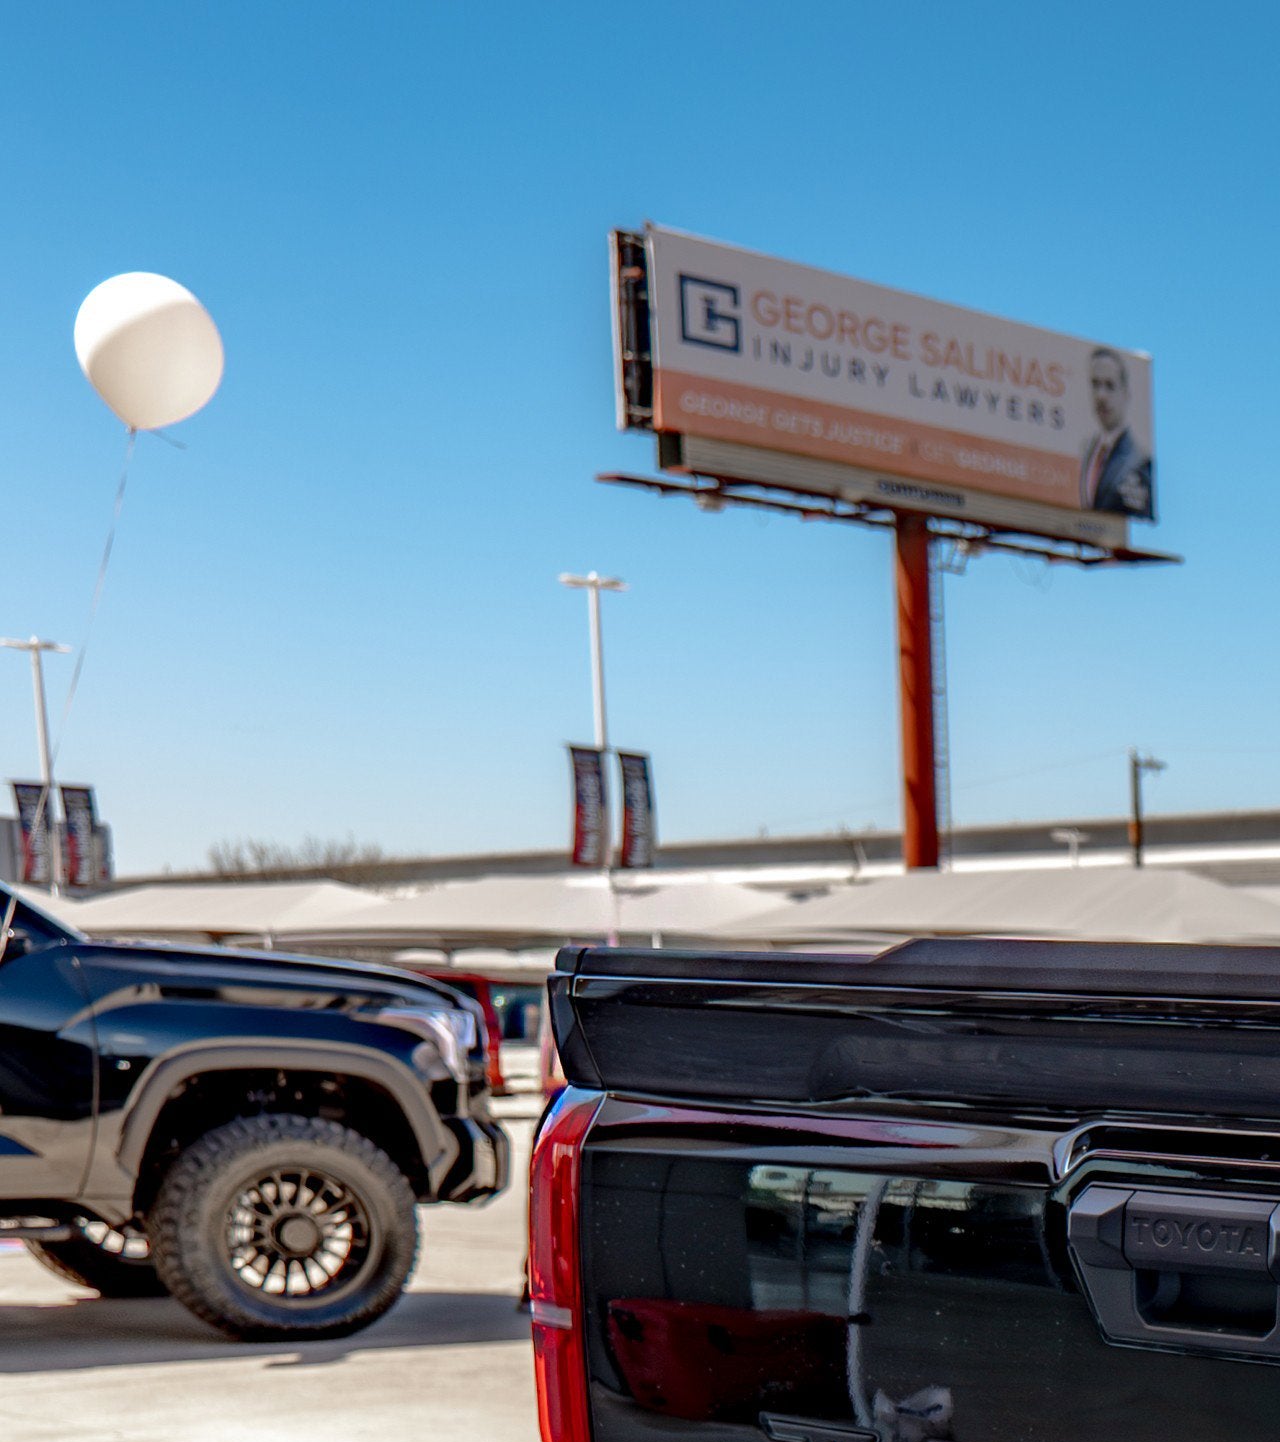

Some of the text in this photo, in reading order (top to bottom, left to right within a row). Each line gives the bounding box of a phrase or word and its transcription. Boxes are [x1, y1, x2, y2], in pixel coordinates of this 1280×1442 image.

[750, 288, 1067, 398] GEORGE SALINAS
[752, 333, 1066, 432] INJURY LAWYERS
[1131, 1216, 1262, 1256] TOYOTA
